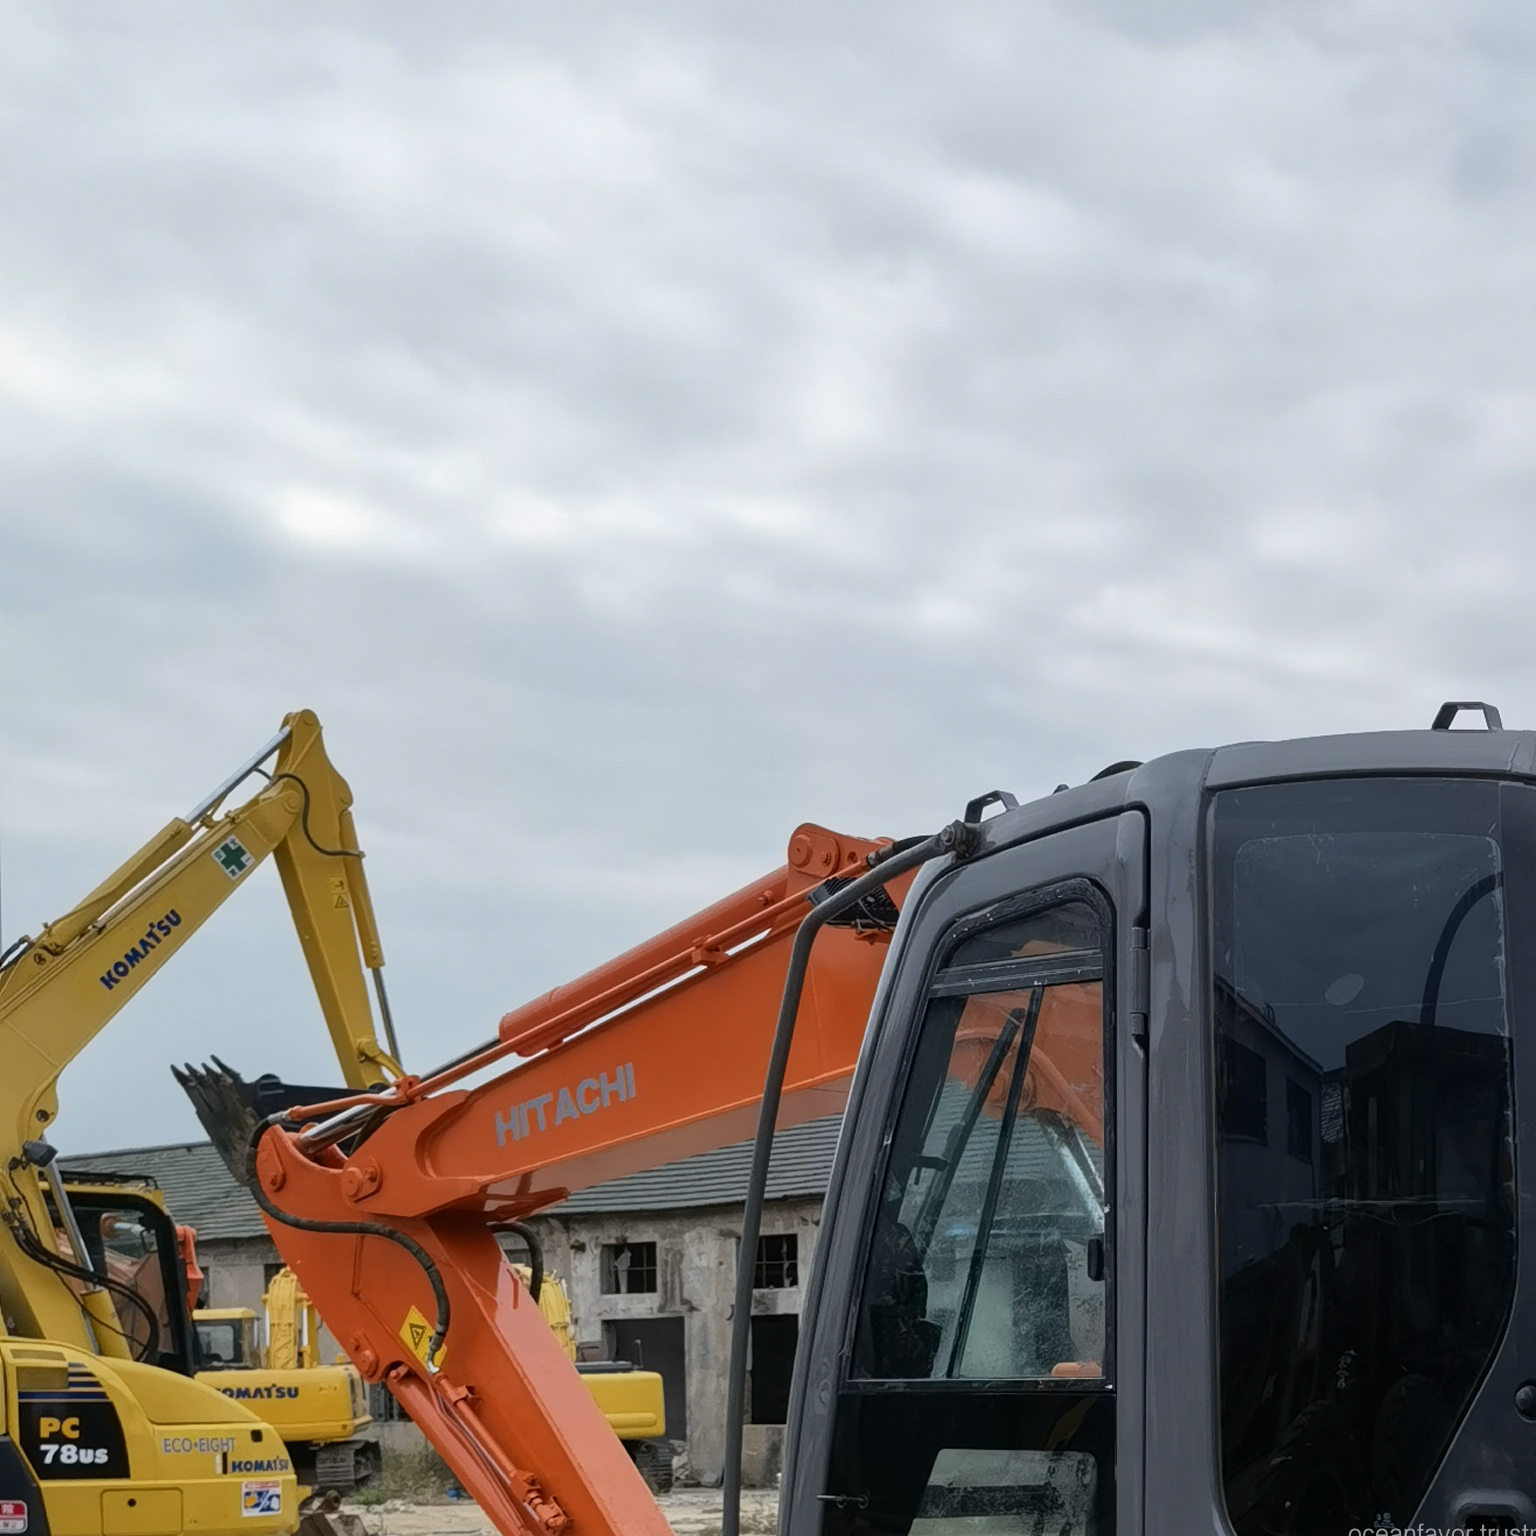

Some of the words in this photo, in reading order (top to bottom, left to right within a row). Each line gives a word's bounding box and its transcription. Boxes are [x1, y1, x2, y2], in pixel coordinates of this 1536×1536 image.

[100, 908, 182, 991] KOMATSU
[494, 1061, 636, 1147] HITACHI
[215, 1382, 300, 1399] OMATSU
[40, 1416, 80, 1439] PC
[231, 1455, 289, 1473] KOMATSU
